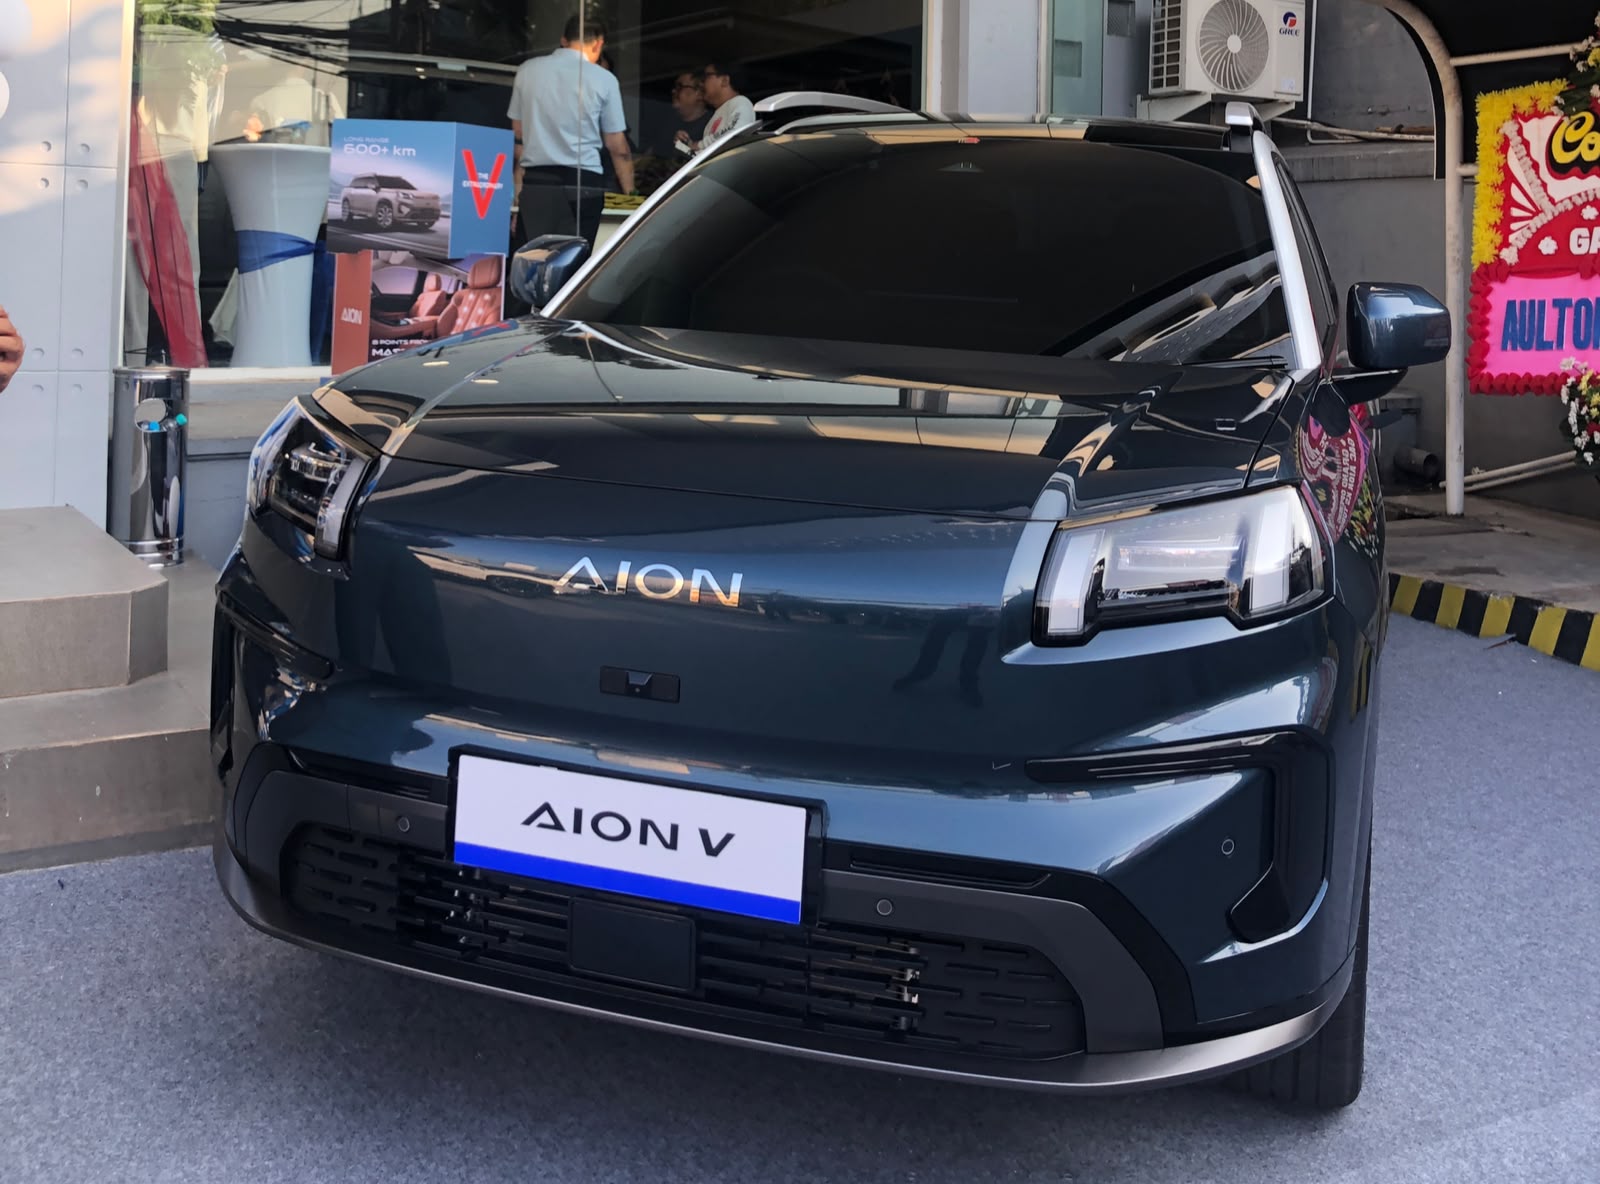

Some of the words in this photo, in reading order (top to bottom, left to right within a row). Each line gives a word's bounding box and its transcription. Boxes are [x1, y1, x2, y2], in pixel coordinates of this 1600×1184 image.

[344, 143, 389, 155] 600+
[393, 145, 416, 156] km
[341, 307, 362, 325] AION
[553, 556, 744, 608] AION
[520, 801, 680, 852] AION
[698, 827, 736, 858] V
